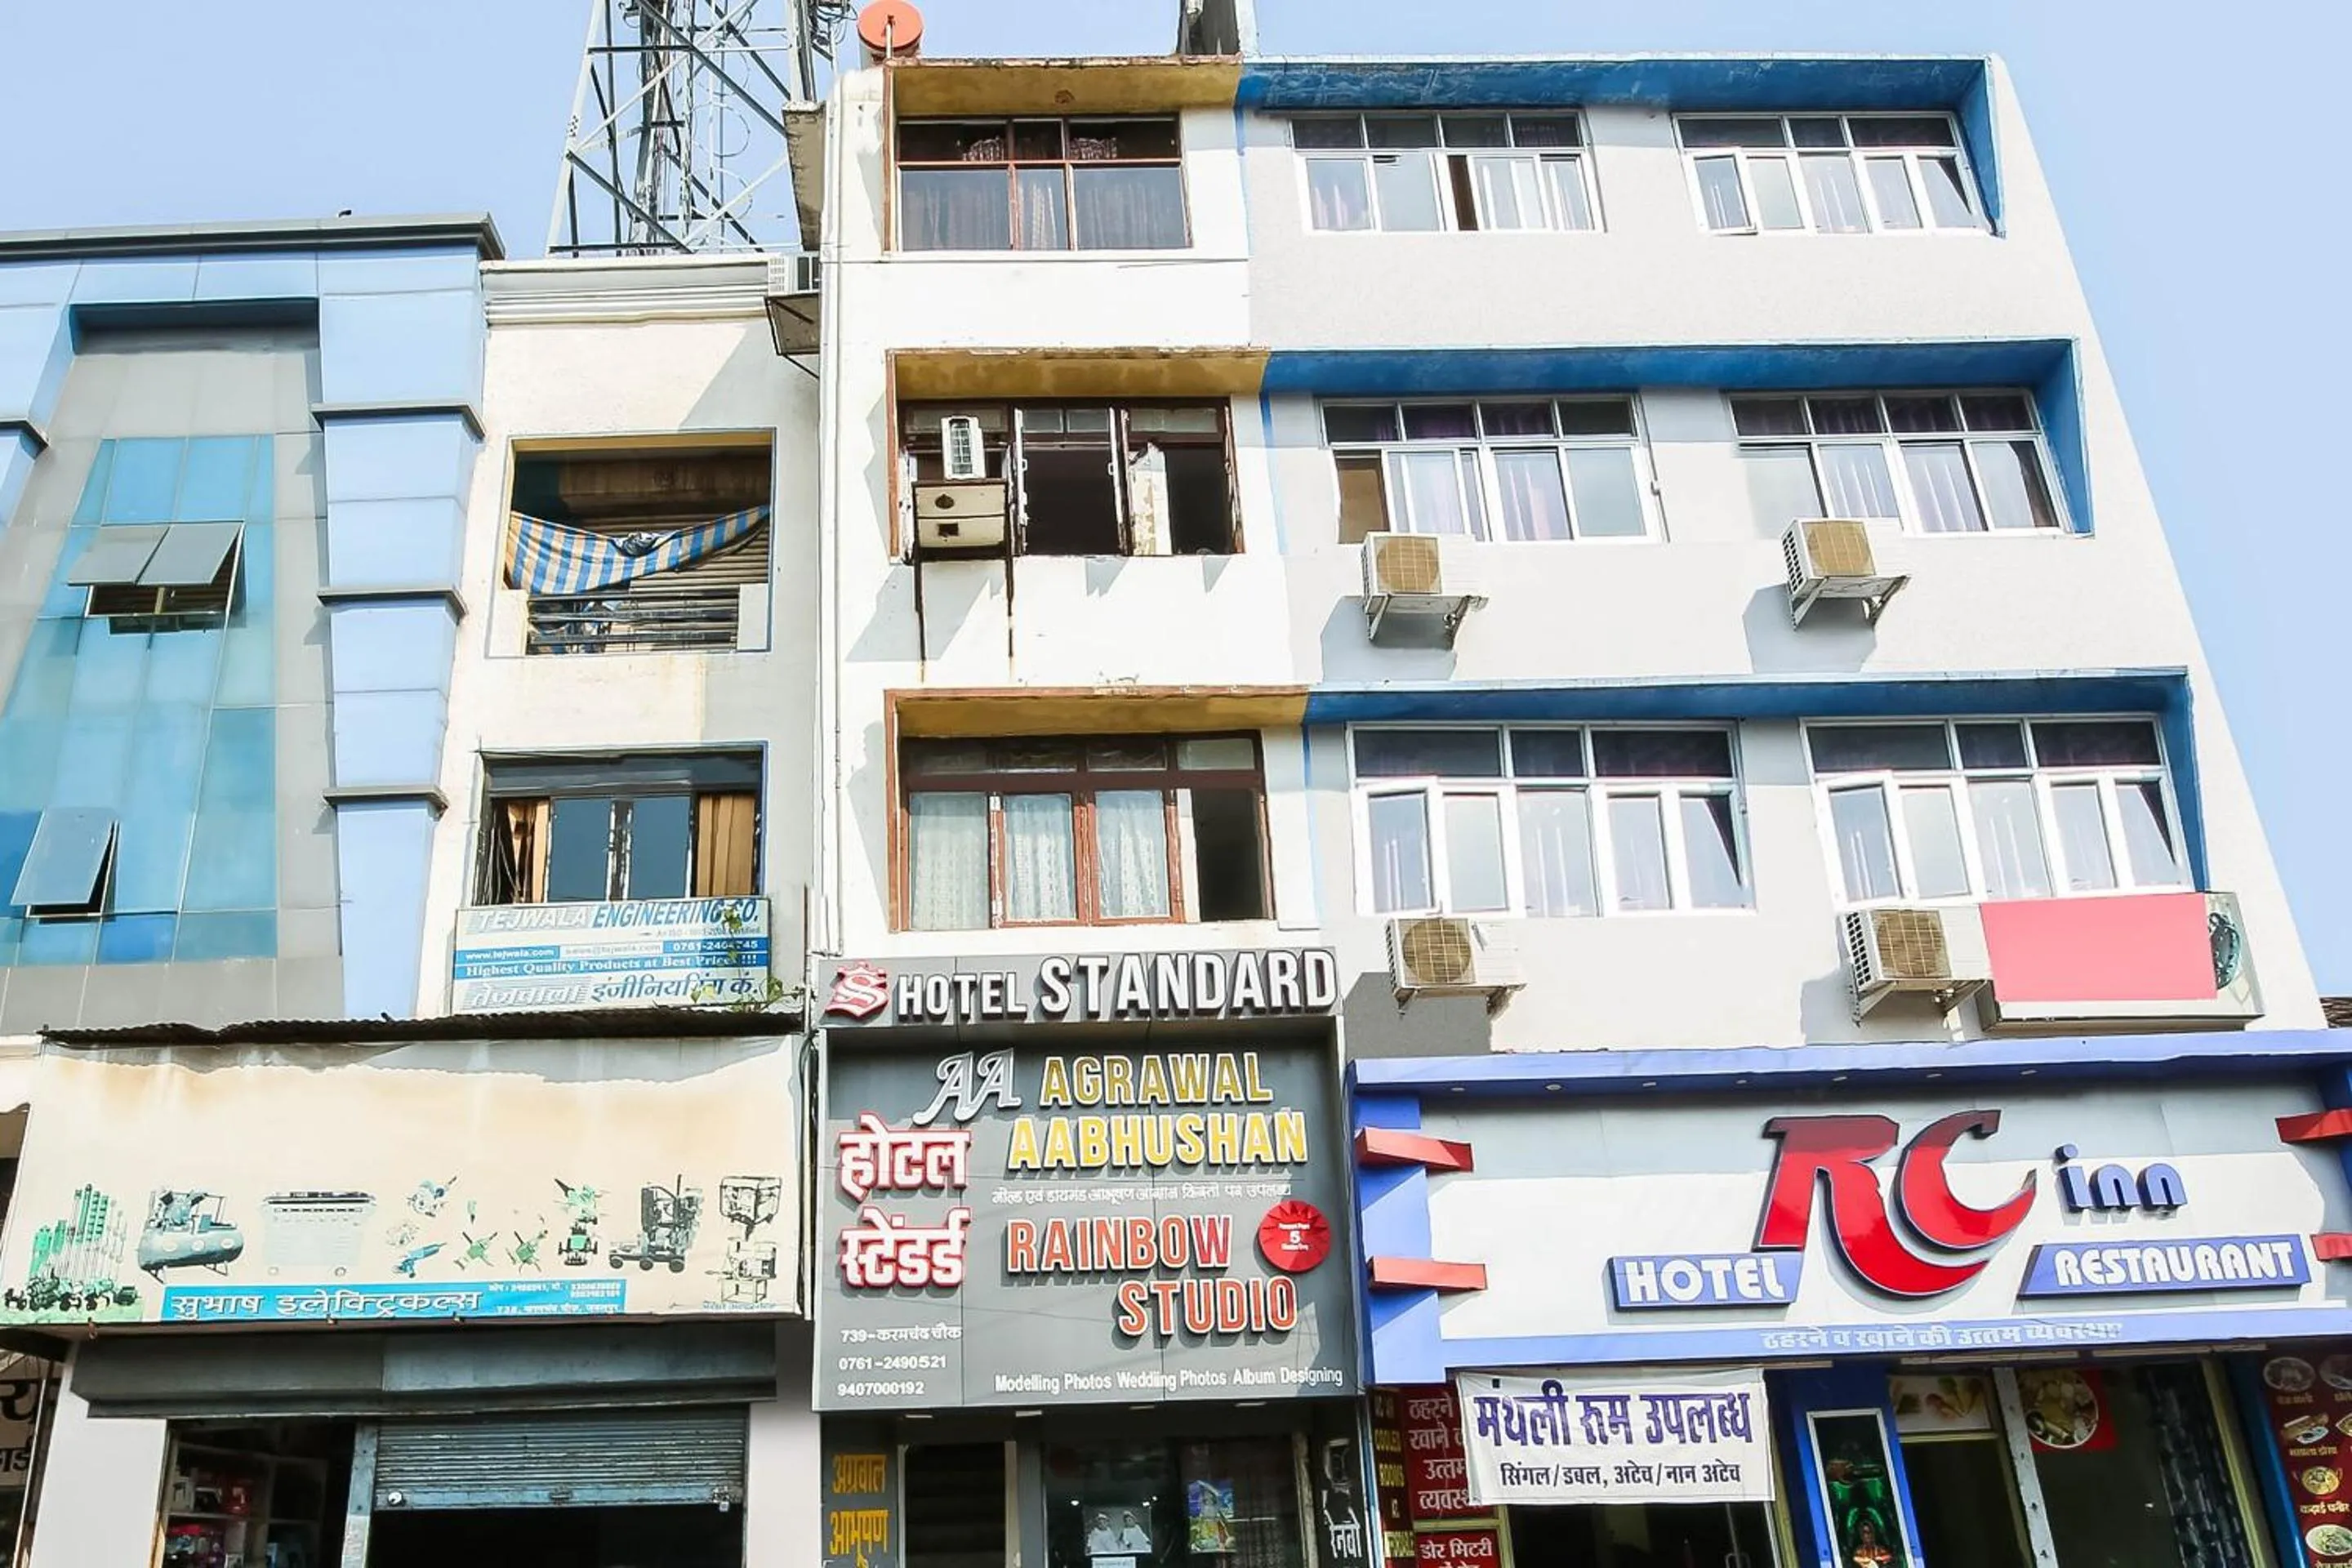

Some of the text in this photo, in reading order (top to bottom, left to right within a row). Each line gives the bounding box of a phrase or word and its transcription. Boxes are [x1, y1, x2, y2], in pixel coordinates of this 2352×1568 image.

[477, 907, 590, 931] TEJWALA
[590, 899, 723, 929] ENGINEERING
[466, 947, 554, 961] www.tejwala.com
[466, 961, 519, 978] Highest
[523, 960, 575, 975] Quality
[579, 956, 639, 972] Products
[645, 956, 658, 968] at
[662, 955, 692, 967] Best
[898, 972, 1029, 1018] HOTEL
[1040, 950, 1338, 1018] STANDARD
[1040, 1052, 1274, 1107] AGRAWAL
[839, 1112, 973, 1204] होटल
[1007, 1110, 1309, 1170] AABHUSHAN
[2053, 1143, 2189, 1213] inn
[1751, 1109, 2038, 1303] RC
[1005, 1214, 1234, 1272] RAINBOW
[2053, 1241, 2295, 1288] RESTAURANT
[1624, 1258, 1786, 1304] HOTEL
[171, 1292, 265, 1320] सुभाष
[1117, 1276, 1299, 1336] STUDIO
[1761, 1325, 1828, 1350] ठहरने
[1856, 1324, 1915, 1348] खाने
[1917, 1324, 1952, 1347] की
[838, 1355, 947, 1370] 0761-2490521
[995, 1373, 1059, 1395] Modelling
[1064, 1372, 1111, 1390] Photos
[1180, 1370, 1226, 1387] Photos
[1232, 1367, 1276, 1385] Album
[1280, 1365, 1343, 1388] Designing
[837, 1381, 925, 1396] 9407000192
[1639, 1393, 1753, 1445] उपलब्ध
[1417, 1489, 1469, 1510] व्यवस्
